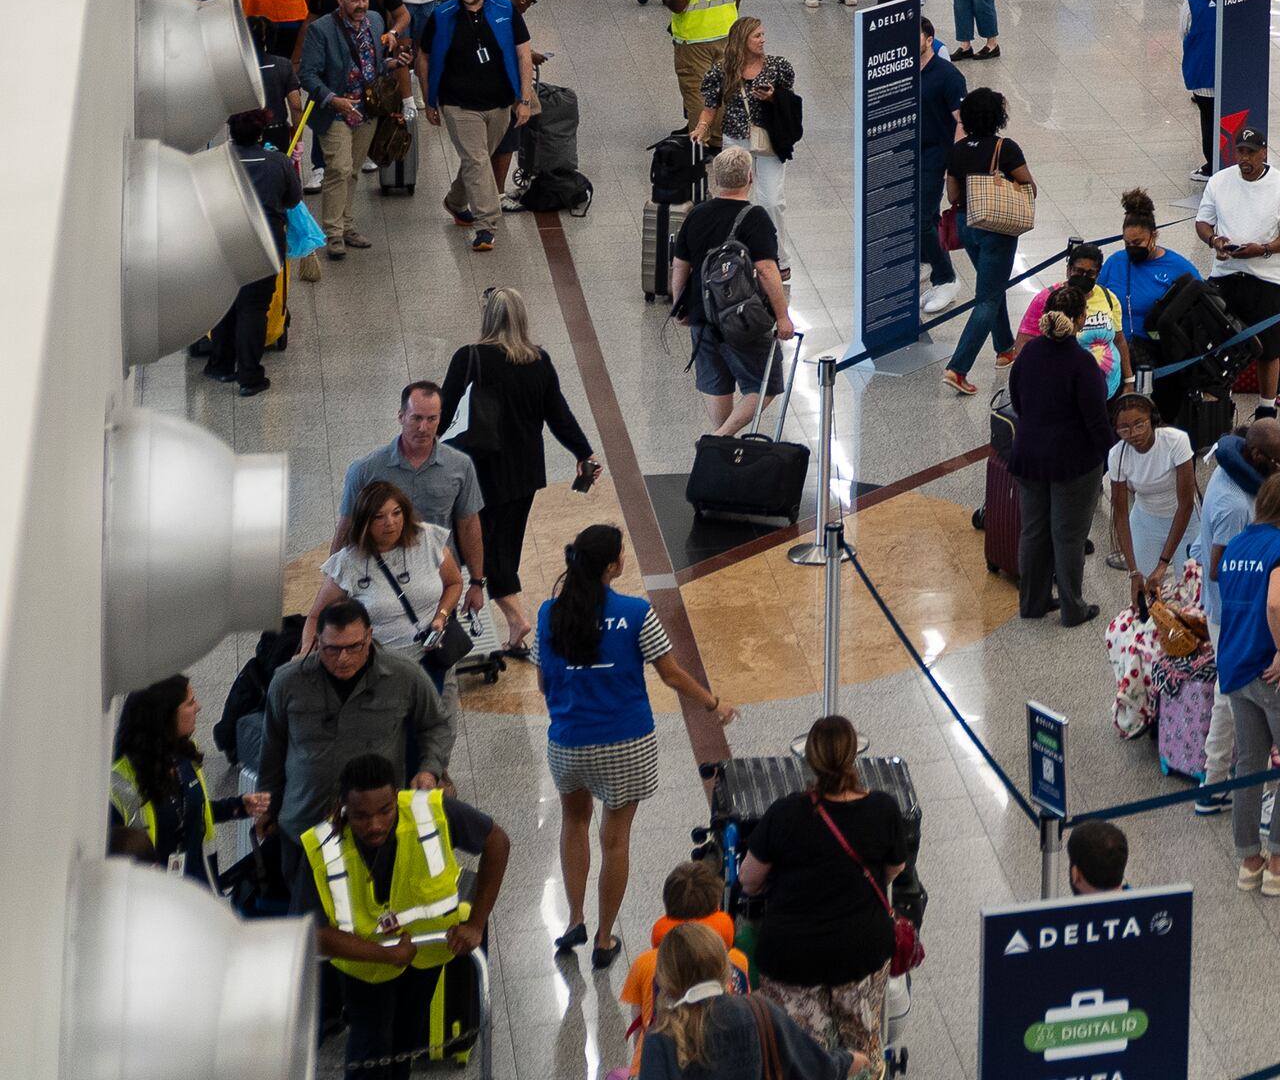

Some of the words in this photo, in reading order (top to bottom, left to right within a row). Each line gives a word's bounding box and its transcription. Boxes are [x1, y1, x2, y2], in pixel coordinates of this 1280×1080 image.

[878, 12, 906, 28] DELTA
[868, 47, 897, 68] ADVICE
[896, 45, 908, 58] TO
[868, 56, 914, 81] PASSENGERS
[1229, 559, 1264, 572] DELTA
[1039, 916, 1141, 949] DELTA
[1061, 1021, 1118, 1041] DIGITAL
[1121, 1017, 1137, 1033] ID
